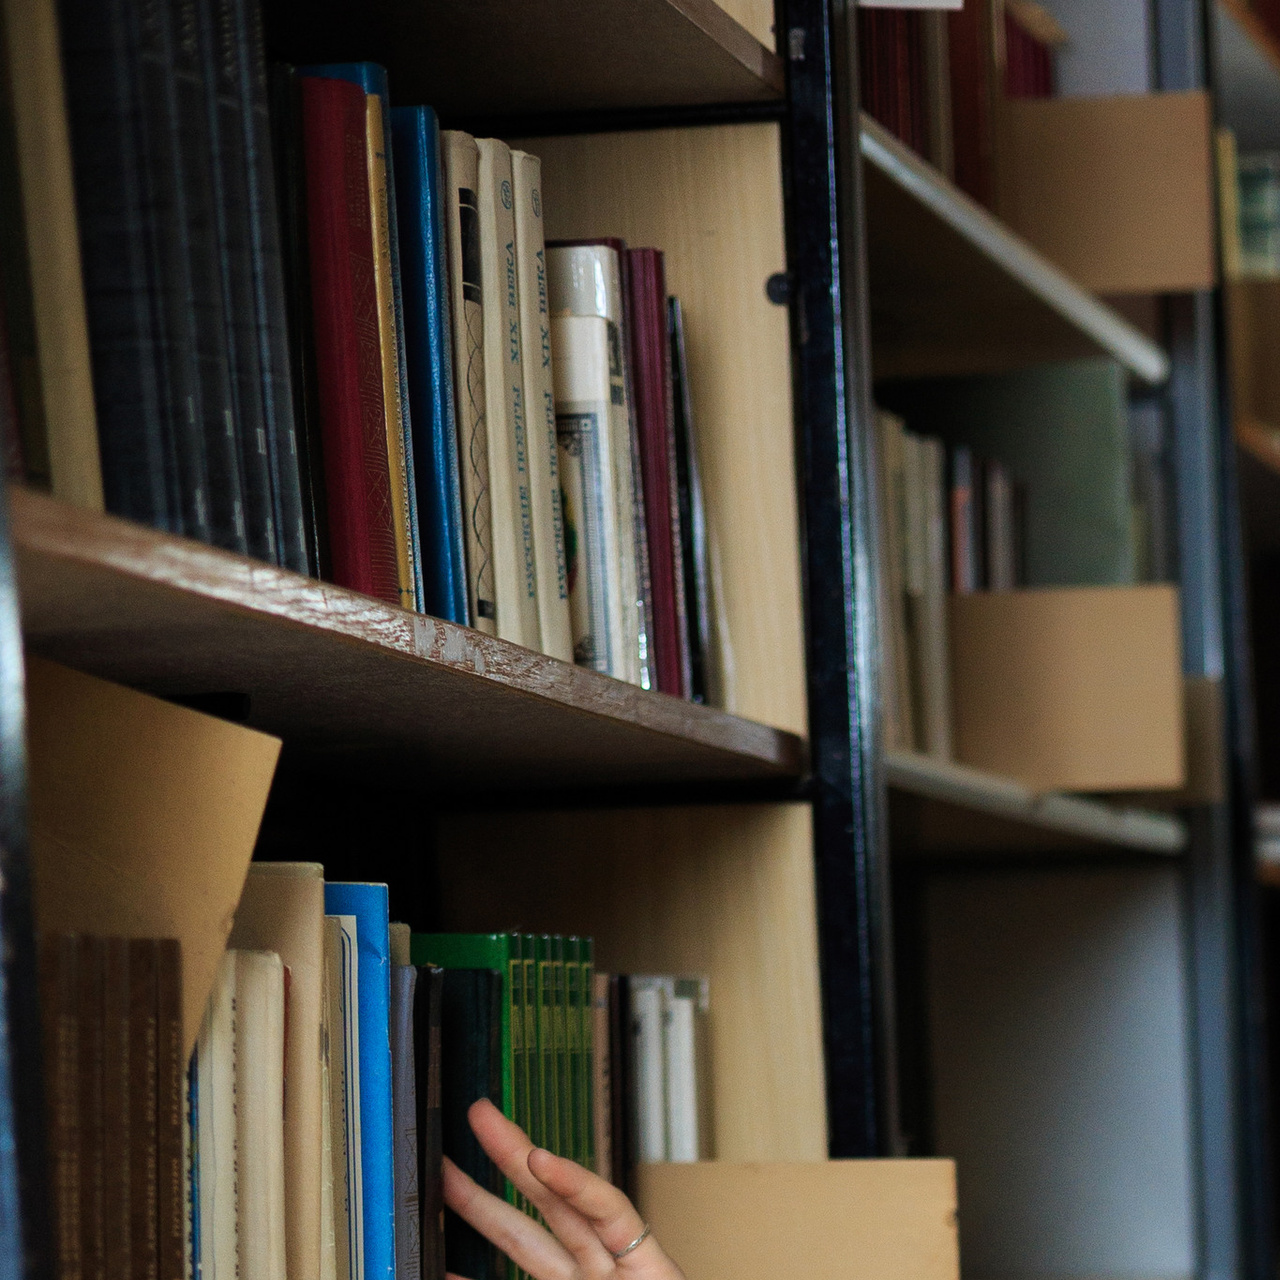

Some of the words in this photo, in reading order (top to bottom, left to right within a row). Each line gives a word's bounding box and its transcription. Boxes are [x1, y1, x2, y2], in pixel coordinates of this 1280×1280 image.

[503, 240, 516, 309] ВЕКА
[535, 248, 547, 315] ВЕКА
[510, 384, 527, 474] ПОЭТЫ
[543, 390, 559, 477] ПОЭТЫ
